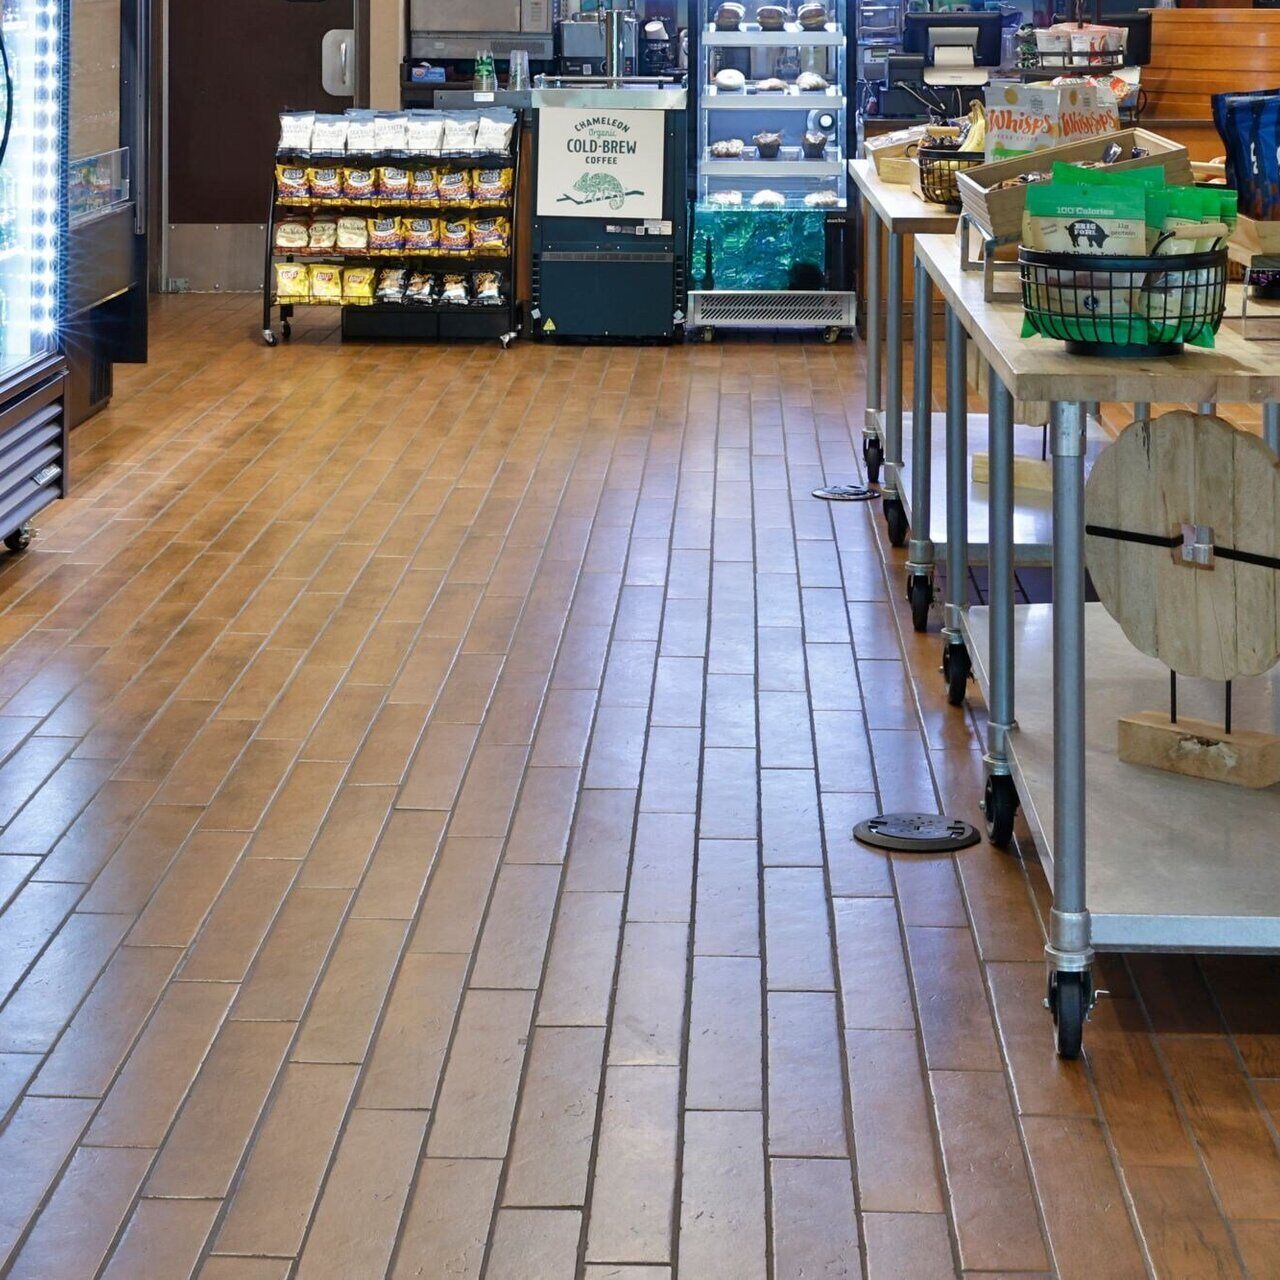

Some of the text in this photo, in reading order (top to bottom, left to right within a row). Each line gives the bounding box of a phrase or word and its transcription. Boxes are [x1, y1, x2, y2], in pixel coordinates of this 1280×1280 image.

[574, 117, 630, 132] CHAMELEON
[988, 109, 1054, 135] Whisps
[588, 128, 617, 139] Organic
[585, 156, 618, 164] COFFEE
[1076, 207, 1114, 215] Calories
